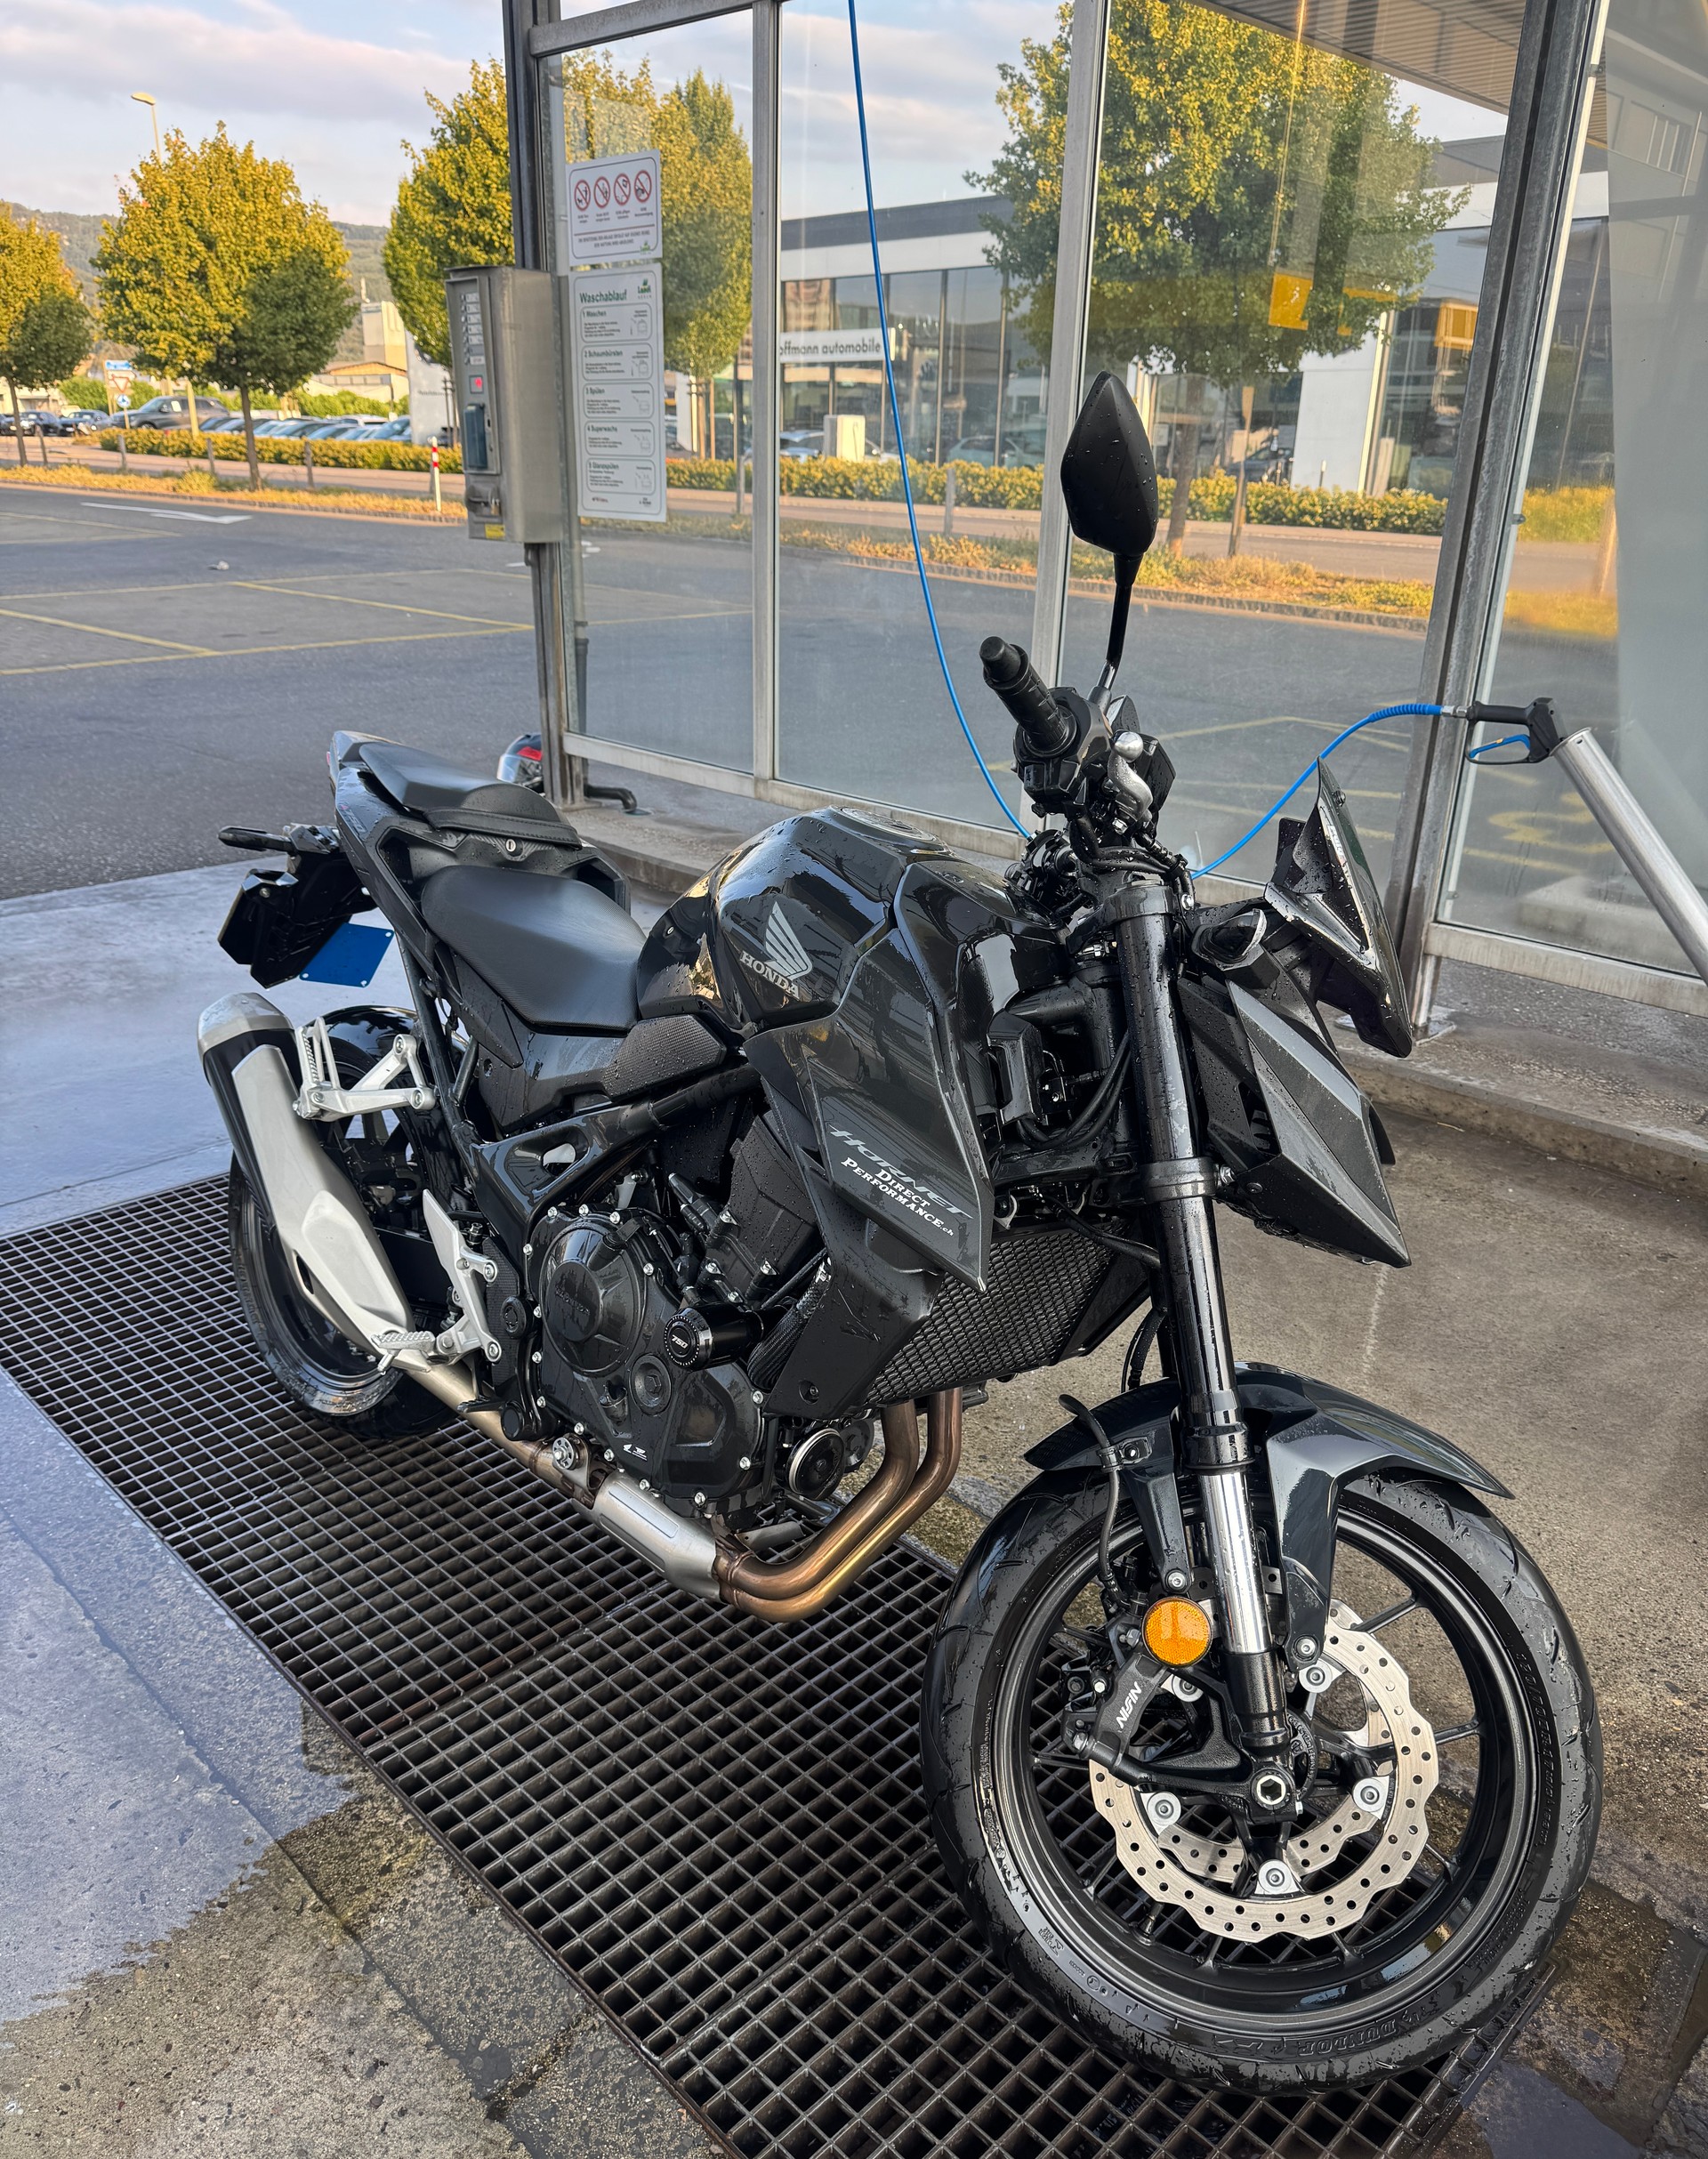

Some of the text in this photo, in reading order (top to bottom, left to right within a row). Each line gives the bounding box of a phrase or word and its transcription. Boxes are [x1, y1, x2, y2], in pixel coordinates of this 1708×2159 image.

[579, 289, 627, 303] Waschablauf
[822, 336, 882, 354] automobile
[739, 950, 801, 1002] HONDA
[828, 1124, 974, 1220] HORNET
[874, 1168, 931, 1208] DIRECT
[671, 1334, 689, 1349] 750
[1297, 2017, 1399, 2058] DUNLOP
